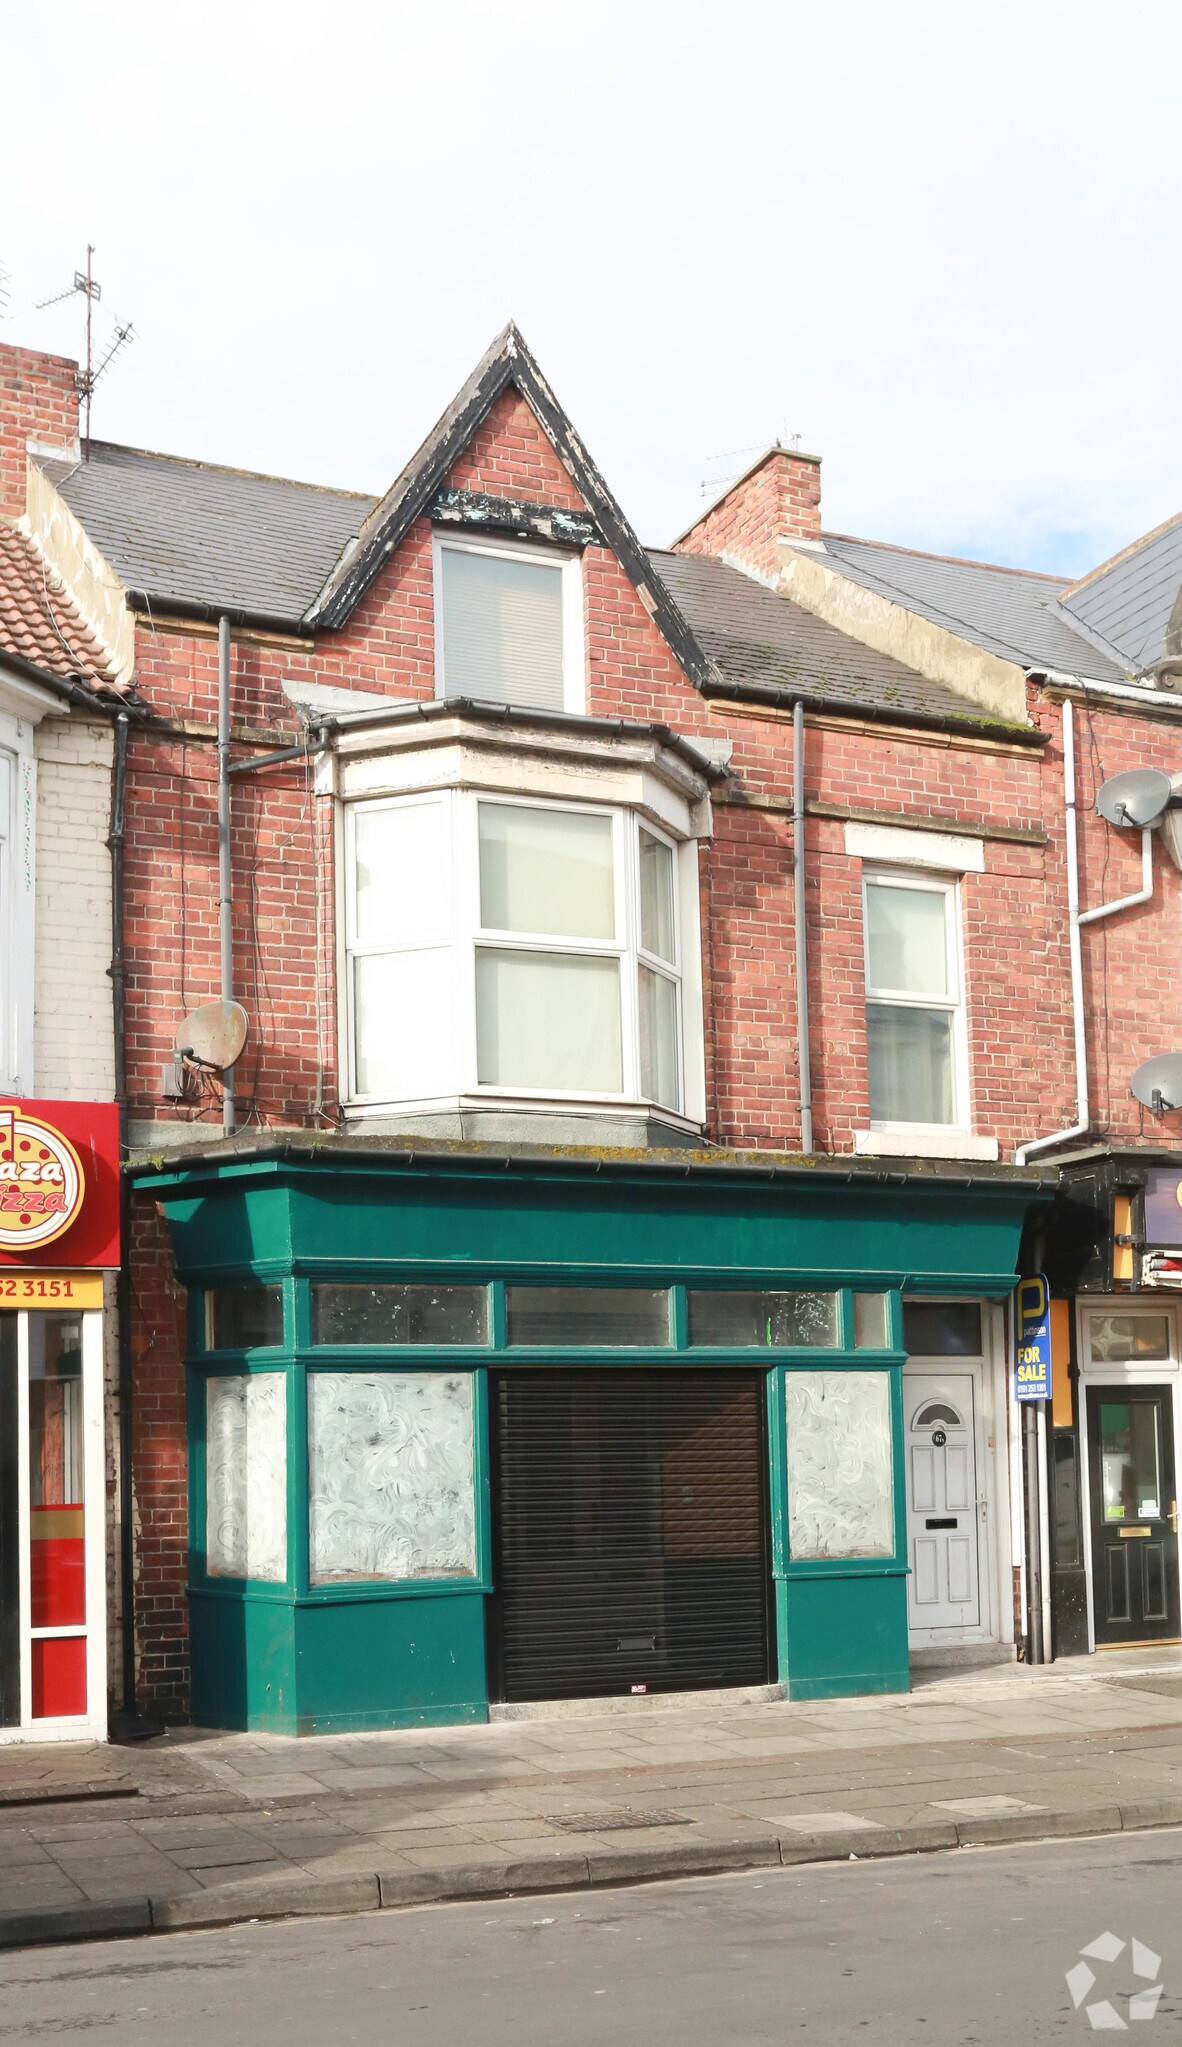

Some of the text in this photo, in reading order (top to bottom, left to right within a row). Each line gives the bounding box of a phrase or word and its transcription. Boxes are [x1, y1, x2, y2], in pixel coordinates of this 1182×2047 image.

[22, 1280, 74, 1297] 3151
[1018, 1346, 1040, 1364] FOR
[1018, 1363, 1046, 1382] SALE
